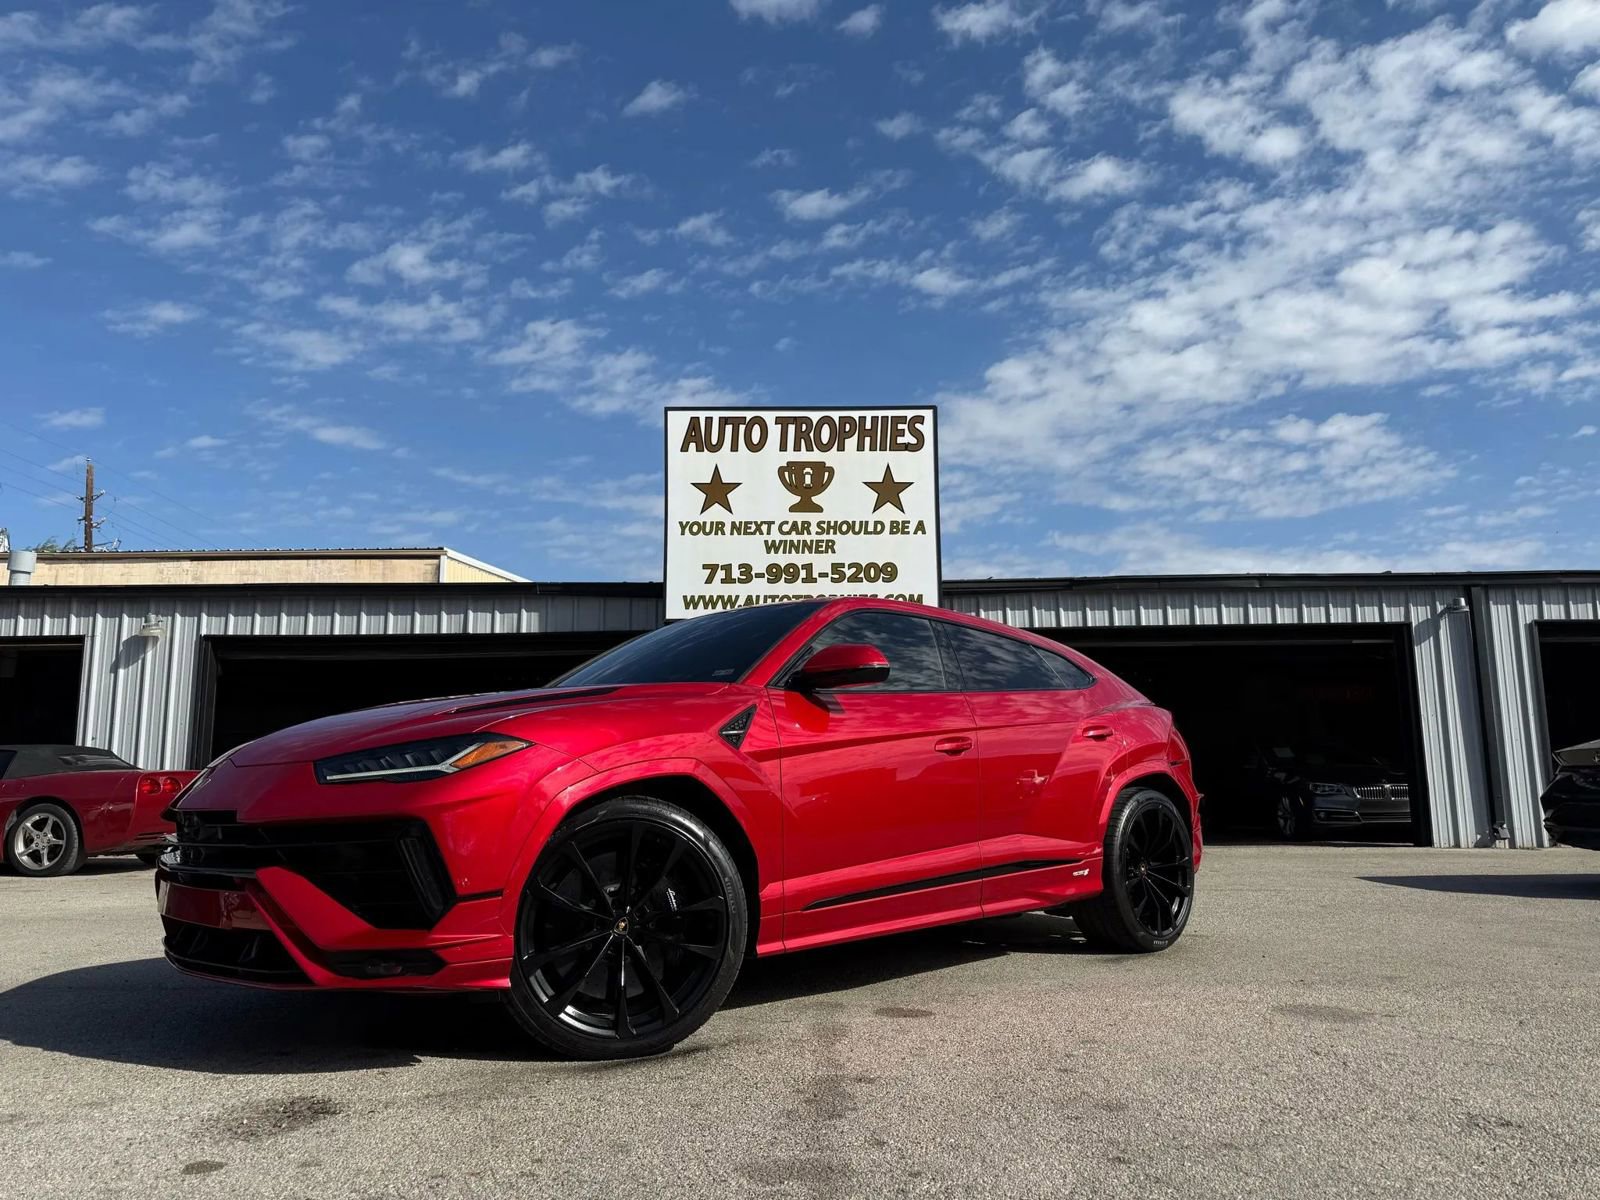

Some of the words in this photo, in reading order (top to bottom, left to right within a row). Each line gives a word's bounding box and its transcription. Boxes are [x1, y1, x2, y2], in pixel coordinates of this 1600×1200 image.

[680, 415, 769, 453] AUTO
[774, 415, 926, 453] TROPHIES
[678, 520, 727, 536] YOUR
[729, 520, 775, 536] NEXT
[777, 520, 812, 536] CAR
[814, 520, 886, 536] SHOULD
[888, 520, 911, 535] BE
[912, 520, 927, 535] A
[763, 539, 837, 555] WINNER
[702, 562, 898, 585] 713-991-5209
[682, 594, 924, 610] WWW.AUTOOM
